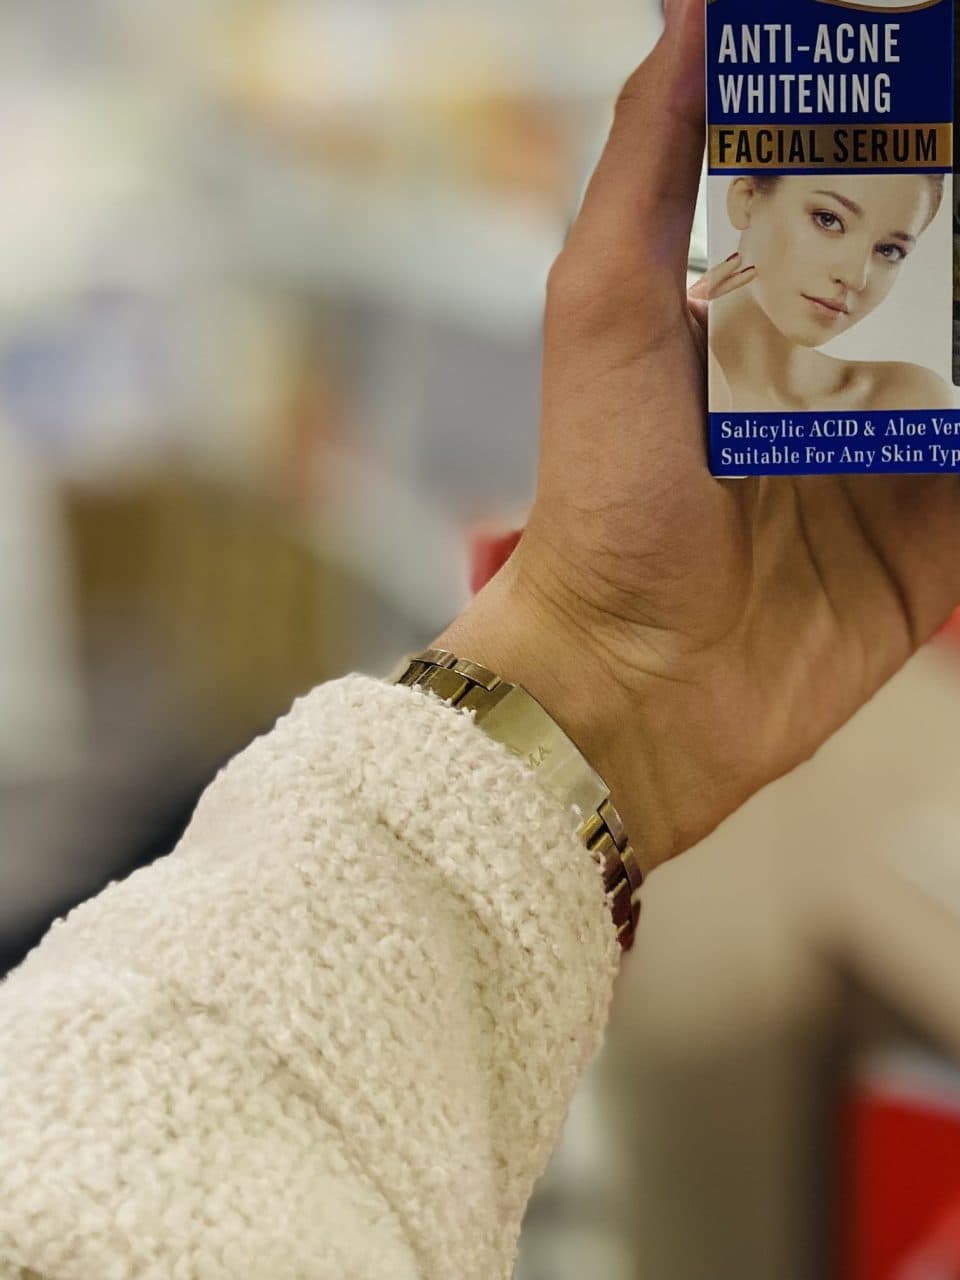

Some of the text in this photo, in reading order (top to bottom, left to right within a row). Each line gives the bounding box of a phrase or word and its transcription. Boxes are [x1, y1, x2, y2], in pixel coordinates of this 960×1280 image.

[718, 23, 901, 64] ANTI-ACNE
[718, 74, 892, 114] WHITENING
[718, 129, 938, 164] FACIAL SERUM
[721, 420, 804, 442] Salicylic
[809, 419, 858, 437] ACID
[863, 420, 876, 437] &
[885, 418, 927, 437] Aloe
[721, 446, 801, 465] Suitable
[805, 447, 836, 464] For
[839, 446, 877, 469] Any
[881, 443, 924, 462] Skin
